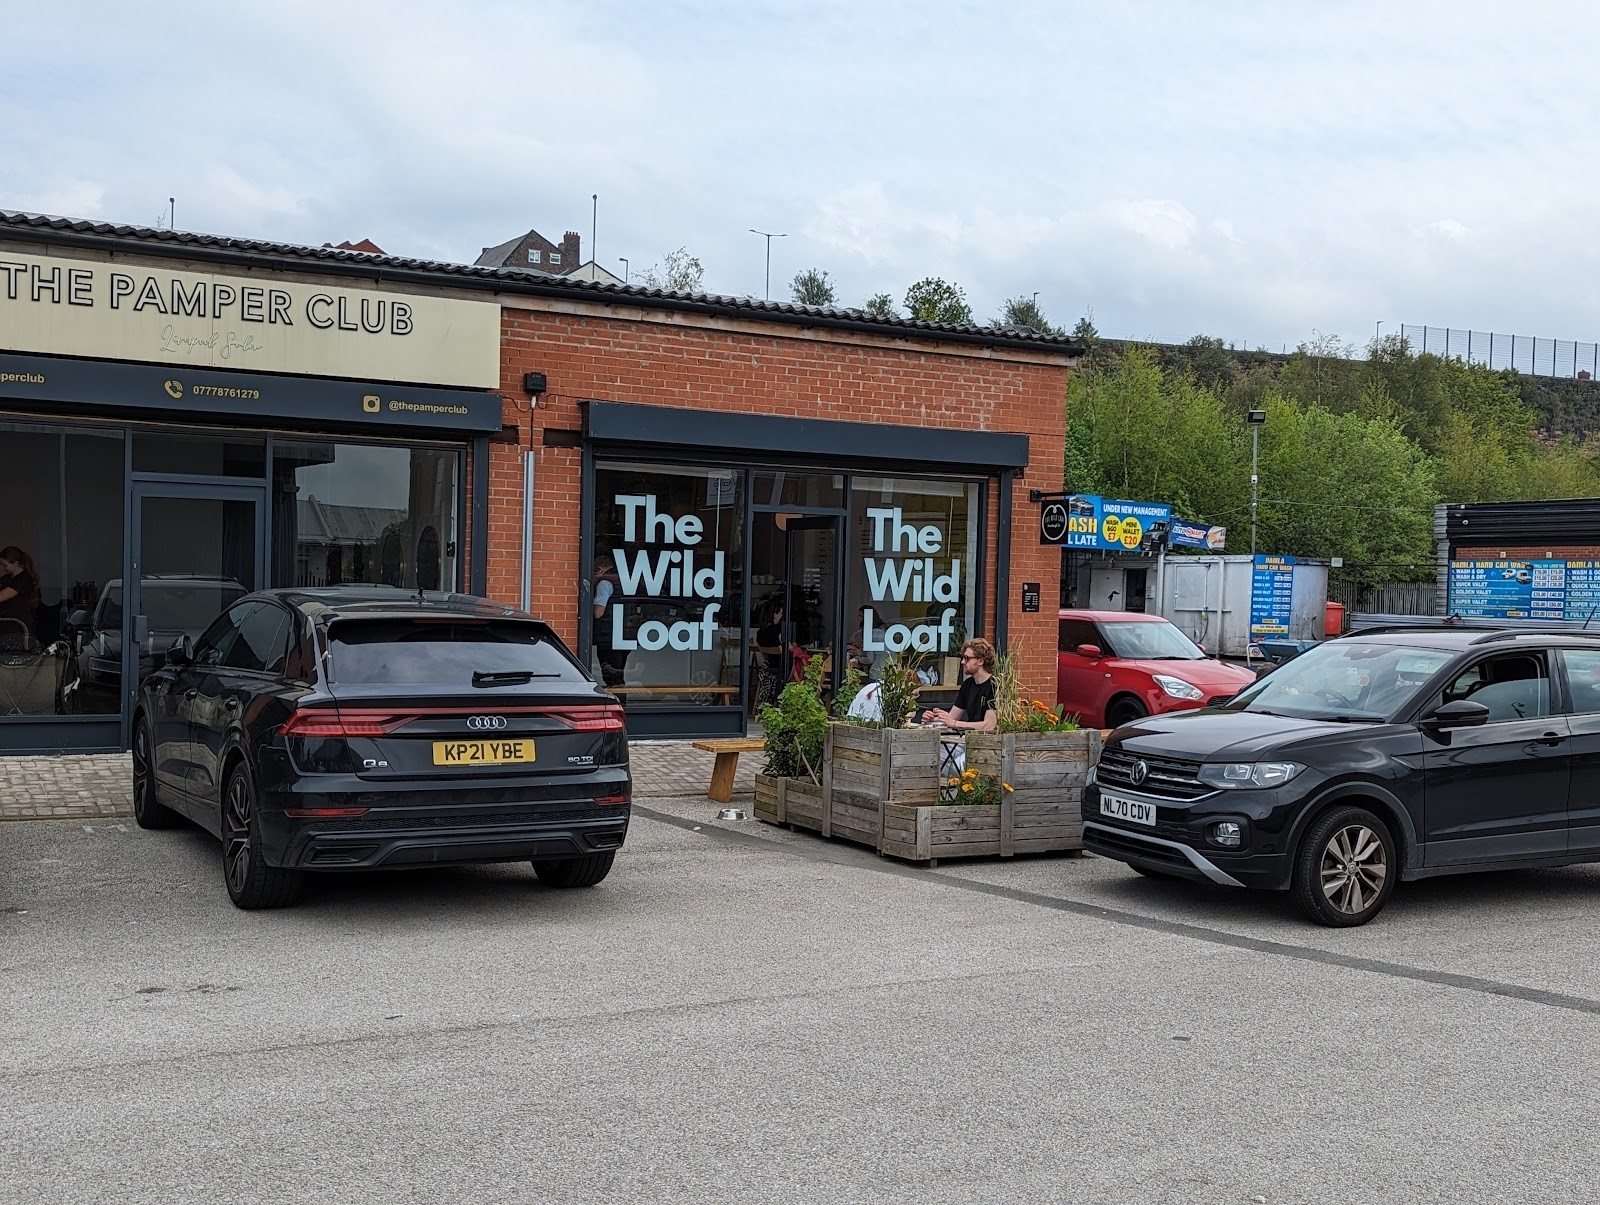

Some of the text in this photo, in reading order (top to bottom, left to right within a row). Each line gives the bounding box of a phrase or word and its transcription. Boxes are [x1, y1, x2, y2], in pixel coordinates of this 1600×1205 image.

[0, 261, 413, 335] THE PAMPER CLUB
[0, 373, 45, 383] perclub
[193, 385, 260, 399] 07778761279
[389, 401, 468, 414] @thepamperclub
[615, 494, 703, 545] The
[1103, 504, 1168, 516] UNDER NEW MANAGEMENT
[866, 507, 942, 554] The
[1075, 534, 1097, 546] LATE
[1124, 536, 1137, 545] £20
[612, 549, 725, 598] Wild
[864, 557, 961, 603] Wild
[612, 603, 721, 650] Loaf
[863, 608, 957, 653] Loaf
[445, 743, 523, 760] KP21 YBE
[364, 759, 387, 768] Q8
[1104, 797, 1151, 821] NL70 CDV
